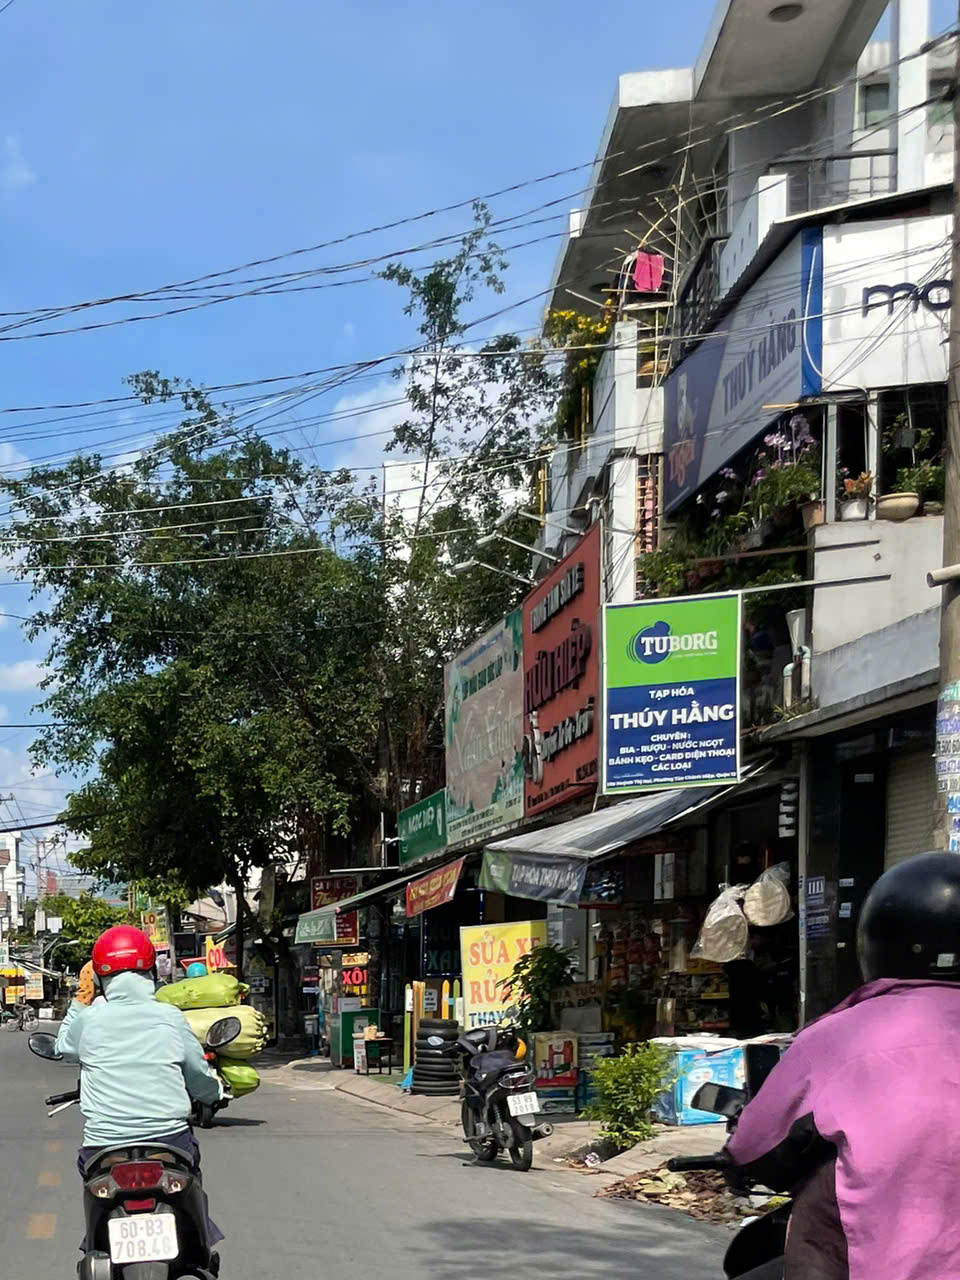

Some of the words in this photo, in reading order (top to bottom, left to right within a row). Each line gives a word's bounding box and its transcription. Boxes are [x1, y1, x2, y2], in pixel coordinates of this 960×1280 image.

[640, 631, 718, 655] TUBORG
[649, 689, 670, 700] TẠP
[671, 686, 694, 697] HÓA
[610, 707, 668, 729] THÚY
[672, 700, 734, 724] HẰNG
[650, 731, 687, 742] CHUYÊN
[619, 746, 635, 754] BIA
[641, 743, 666, 753] RƯỢU
[672, 740, 698, 749] NƯỚC
[699, 738, 724, 748] NGỌT
[609, 756, 634, 765] BÁNH
[635, 755, 653, 764] KẸO
[660, 752, 683, 761] CARD
[707, 748, 735, 757] THOẠI
[651, 762, 670, 771] CÁC
[671, 762, 691, 771] LOẠI
[470, 931, 510, 966] SỬA
[342, 967, 368, 985] XÔI
